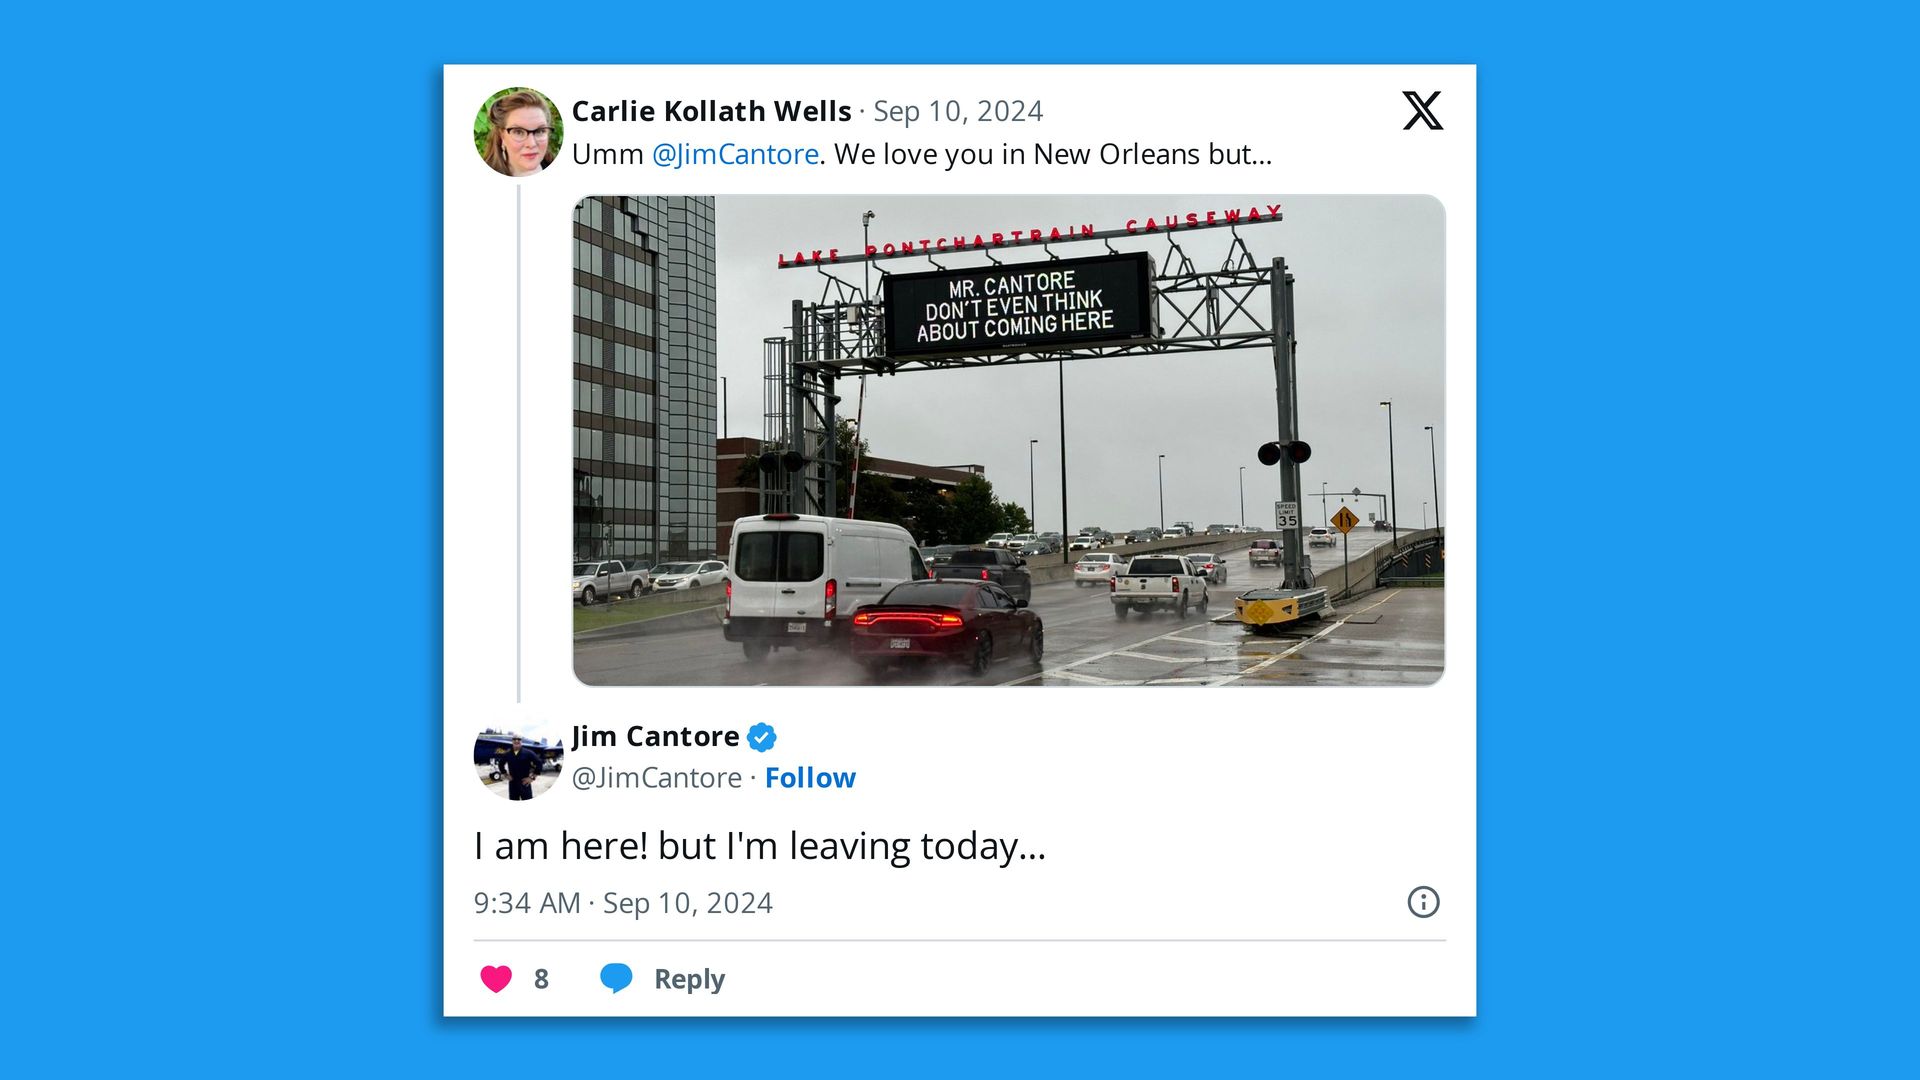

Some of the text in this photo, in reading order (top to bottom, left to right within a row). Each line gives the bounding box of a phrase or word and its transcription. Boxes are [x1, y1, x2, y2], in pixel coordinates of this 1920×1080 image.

[778, 205, 1281, 267] LAKE PONTCHARTRAIN CAUSEWAY
[949, 270, 1076, 299] MR. CANTORE
[926, 289, 1103, 321] DON'T EVEN THINK
[917, 309, 1114, 343] ABOUT COMING HERE
[1278, 516, 1297, 526] 35
